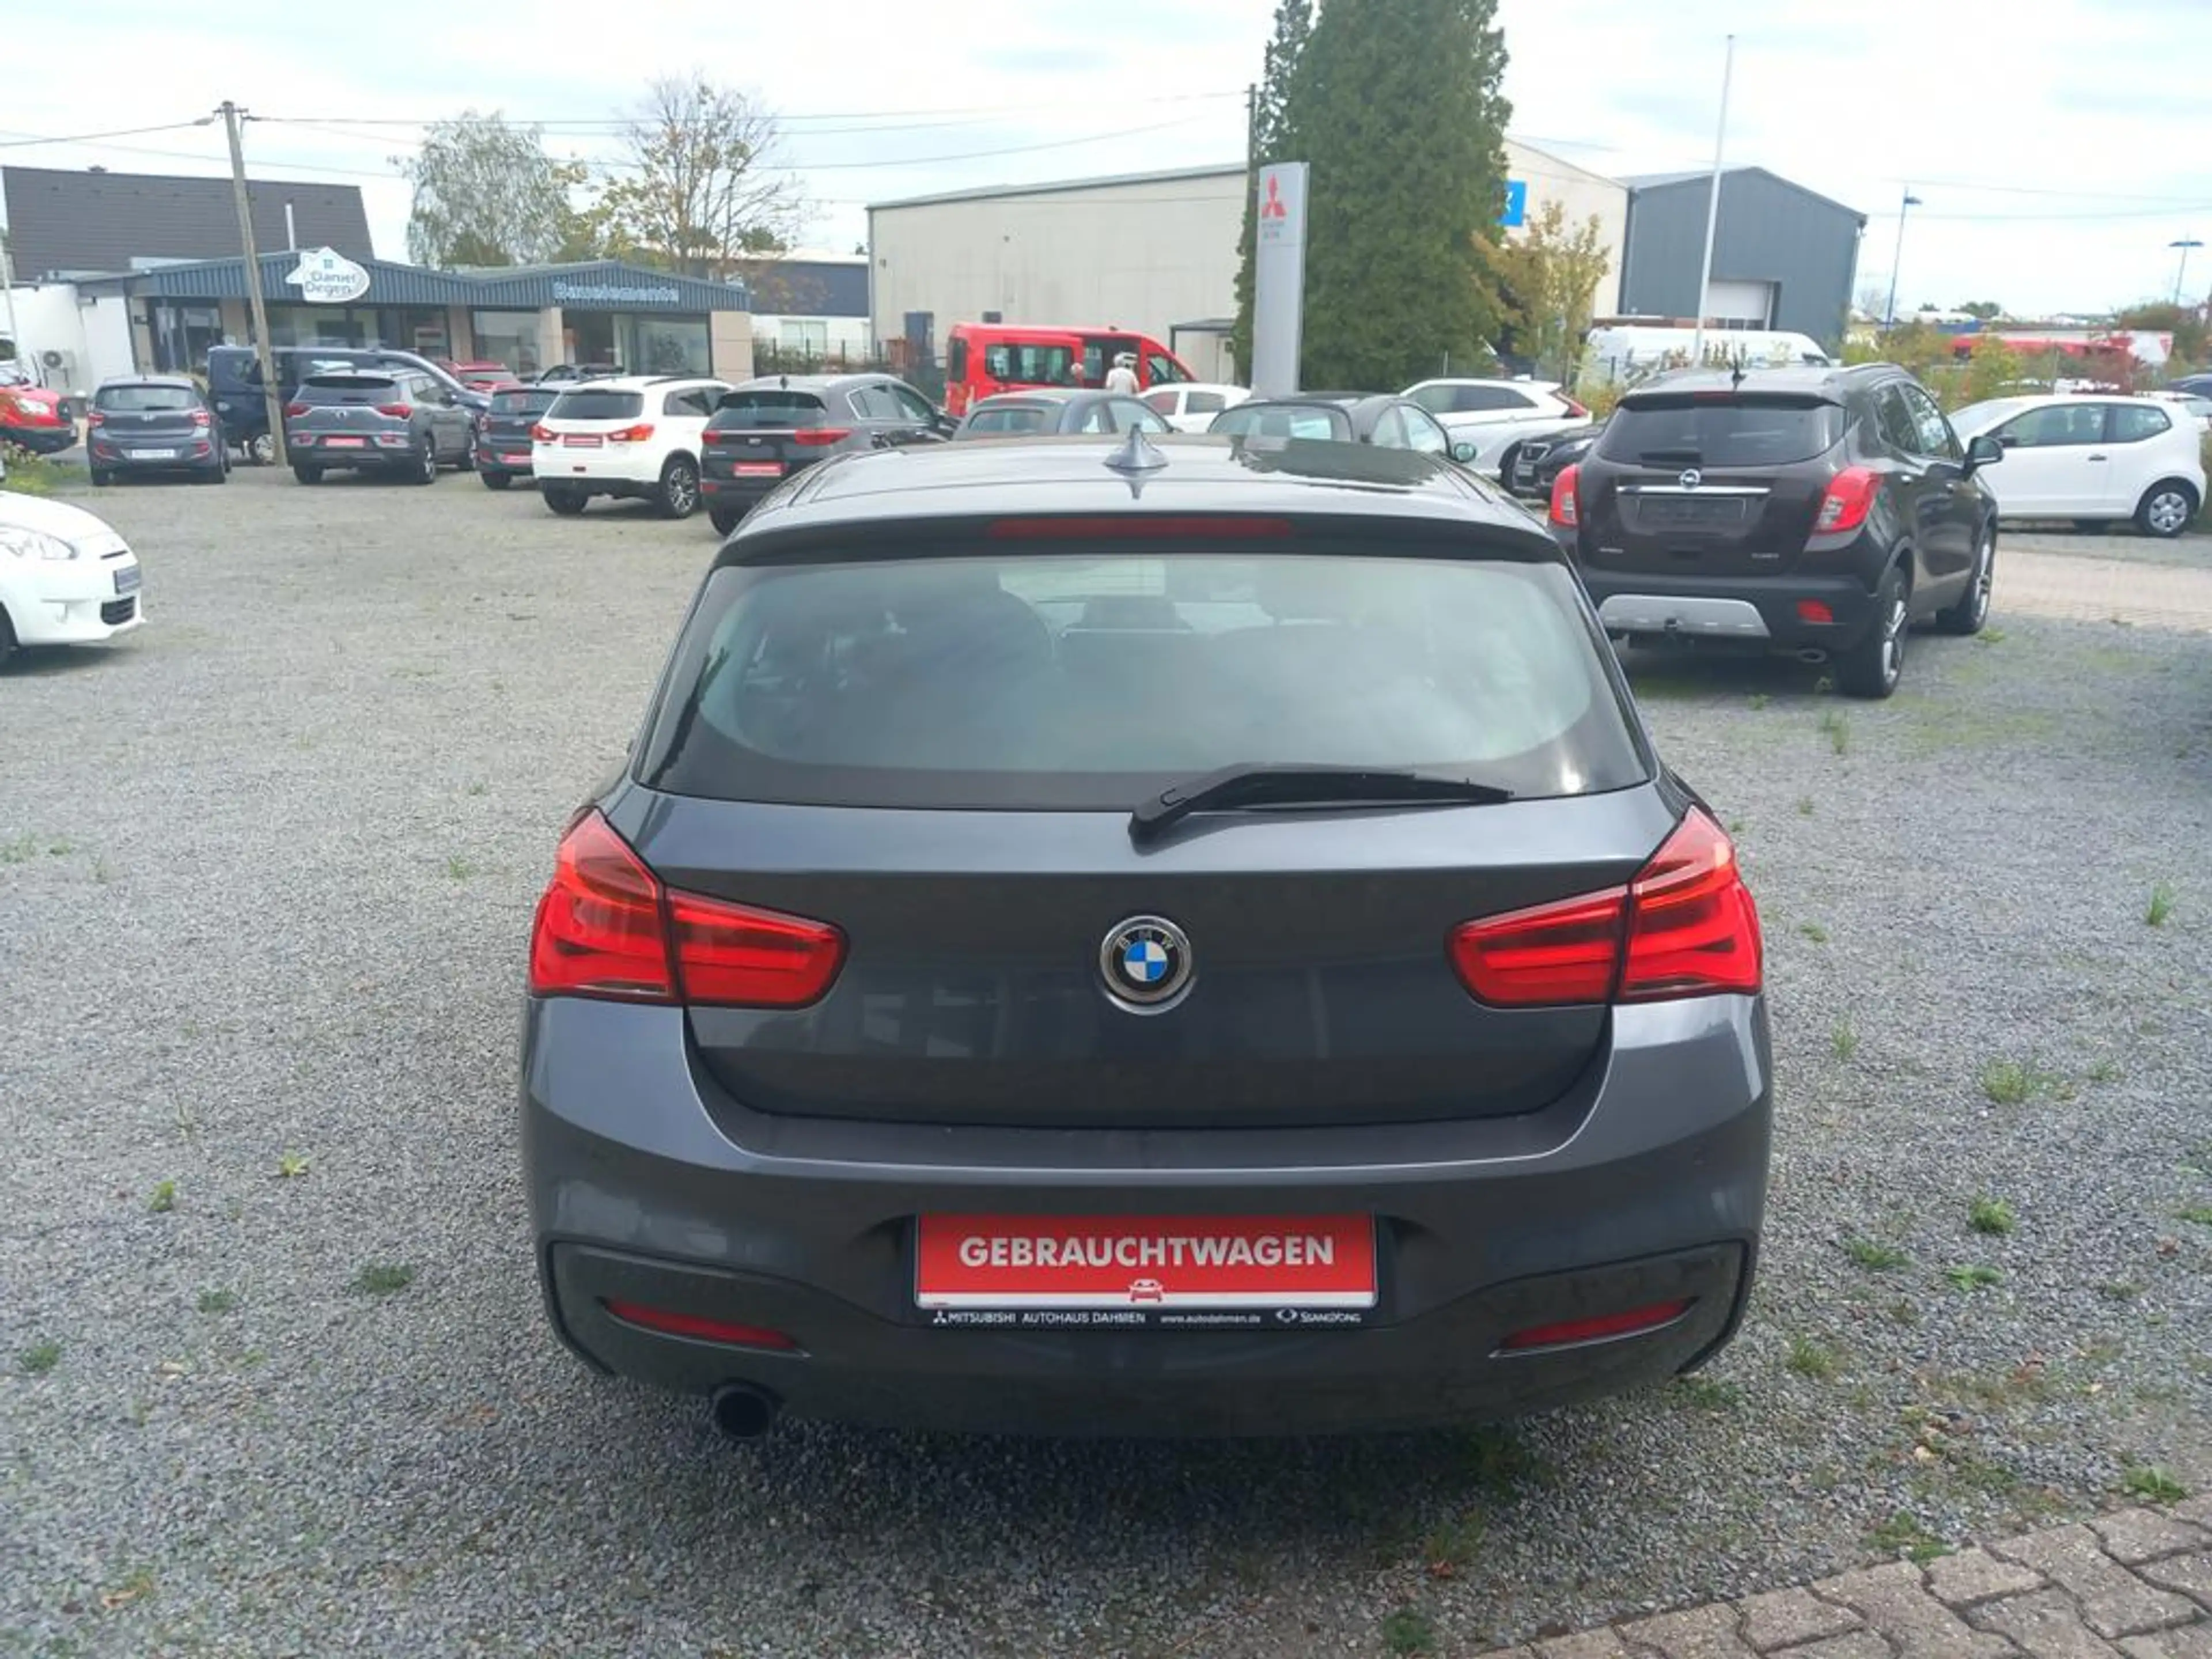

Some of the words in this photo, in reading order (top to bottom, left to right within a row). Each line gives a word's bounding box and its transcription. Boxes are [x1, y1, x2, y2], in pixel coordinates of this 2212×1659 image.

[960, 1236, 1334, 1267] GEBRAUCHTWAGEN
[948, 1311, 1016, 1323] MITSUBISHI
[1022, 1311, 1089, 1323] AUTOHAUS
[1093, 1311, 1146, 1323] DAHMEN
